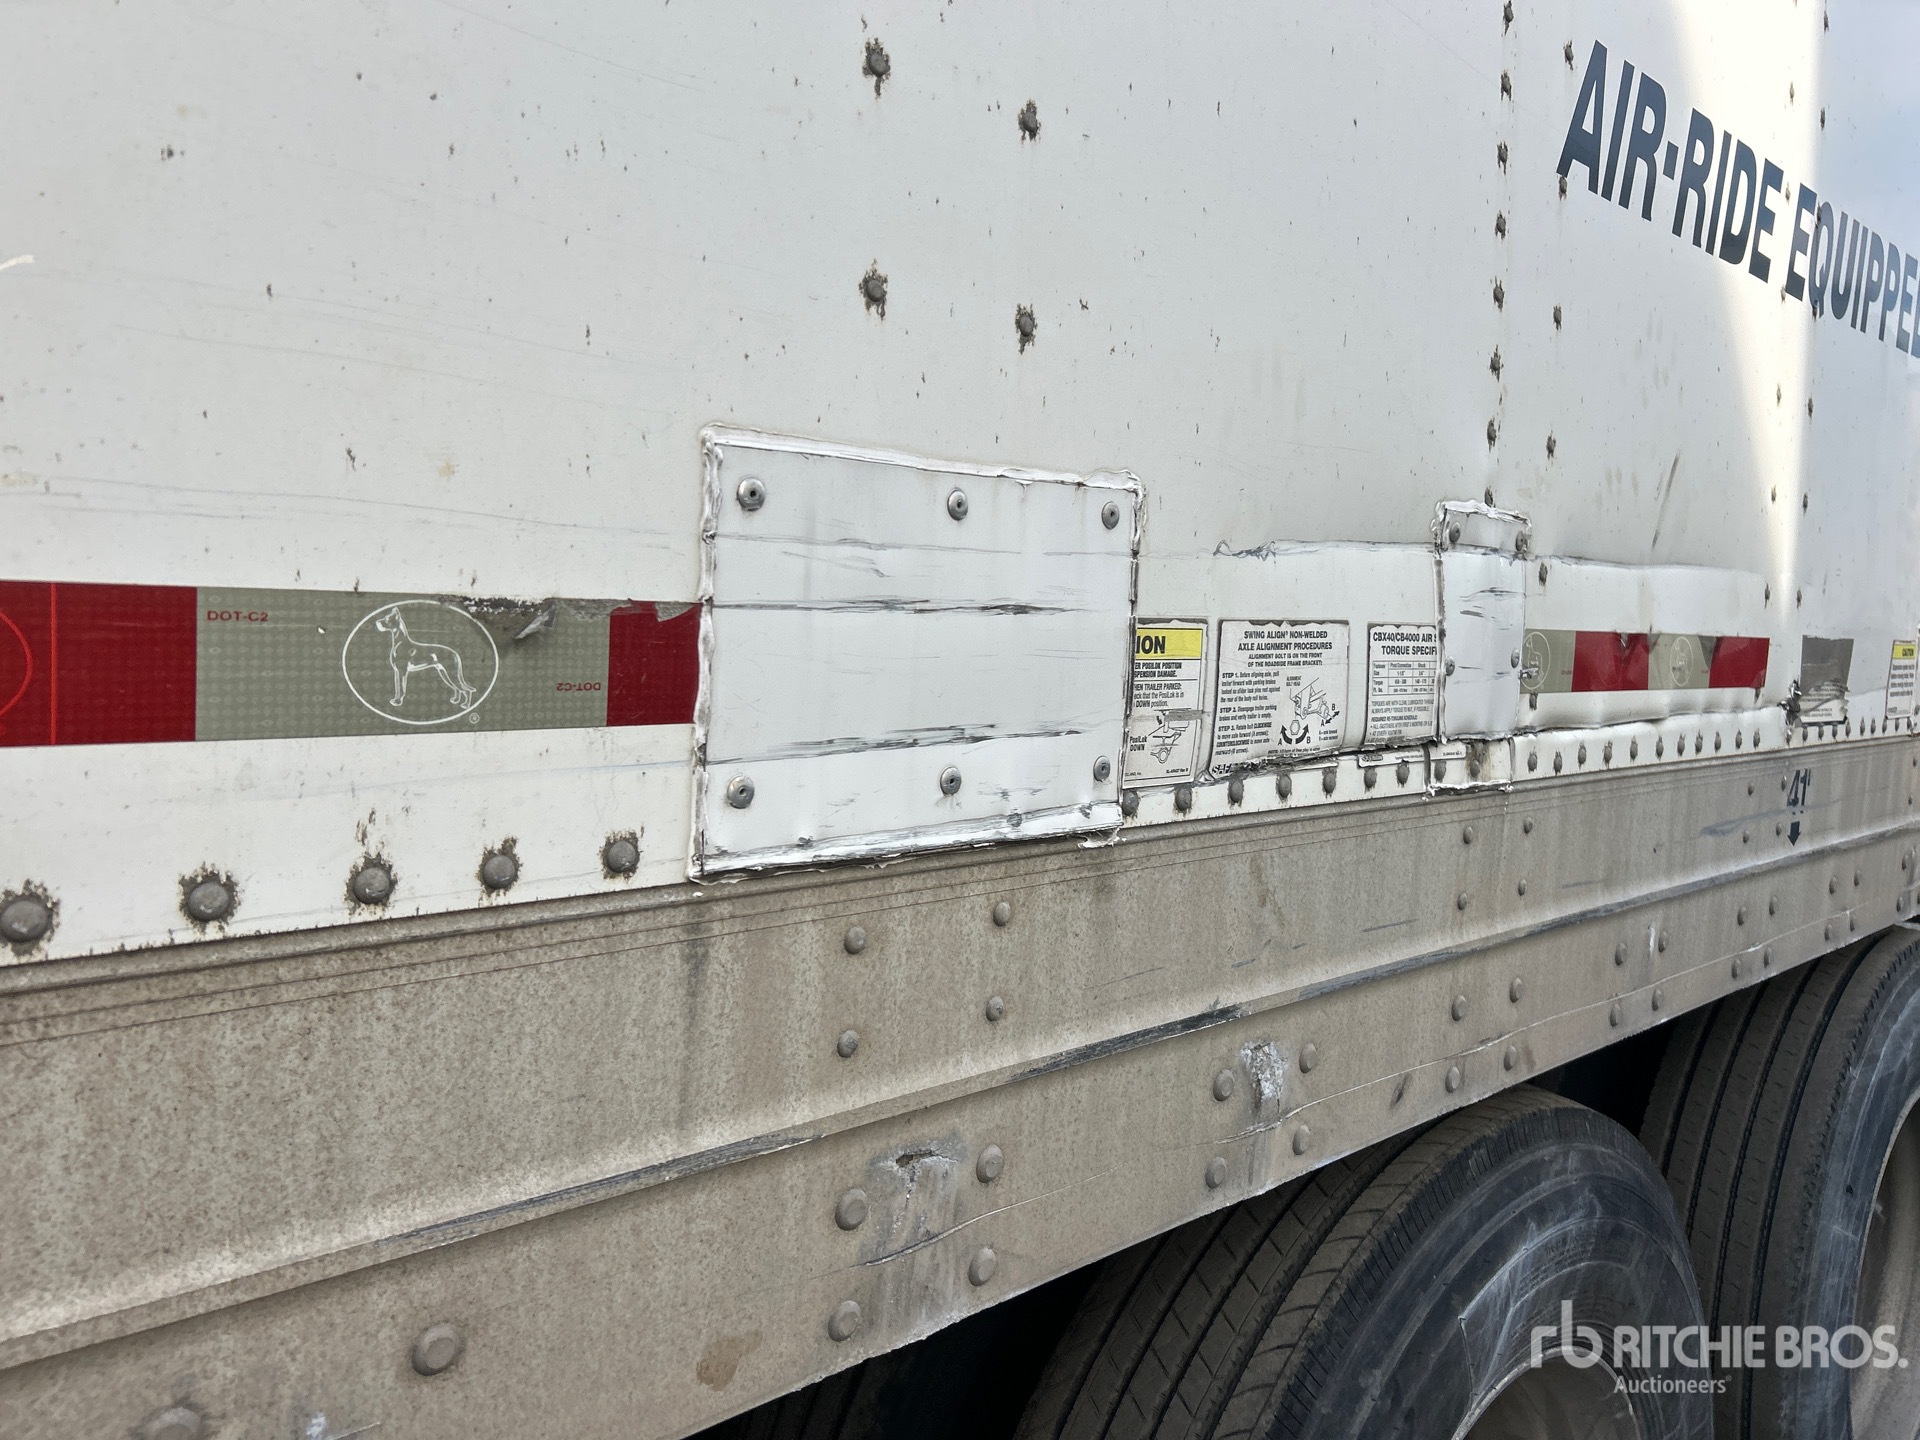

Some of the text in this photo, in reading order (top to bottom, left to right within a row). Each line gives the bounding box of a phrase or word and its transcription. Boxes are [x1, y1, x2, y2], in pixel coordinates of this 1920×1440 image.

[1556, 39, 1784, 283] AIR-RIDE
[206, 610, 269, 622] DOT-C2
[1244, 631, 1265, 639] SWING
[1421, 633, 1432, 642] AIR
[1238, 642, 1332, 651] AXLE ALIGNMENT PROCEDURES
[1381, 645, 1410, 655] TORQUE
[556, 682, 602, 692] DOT-C2
